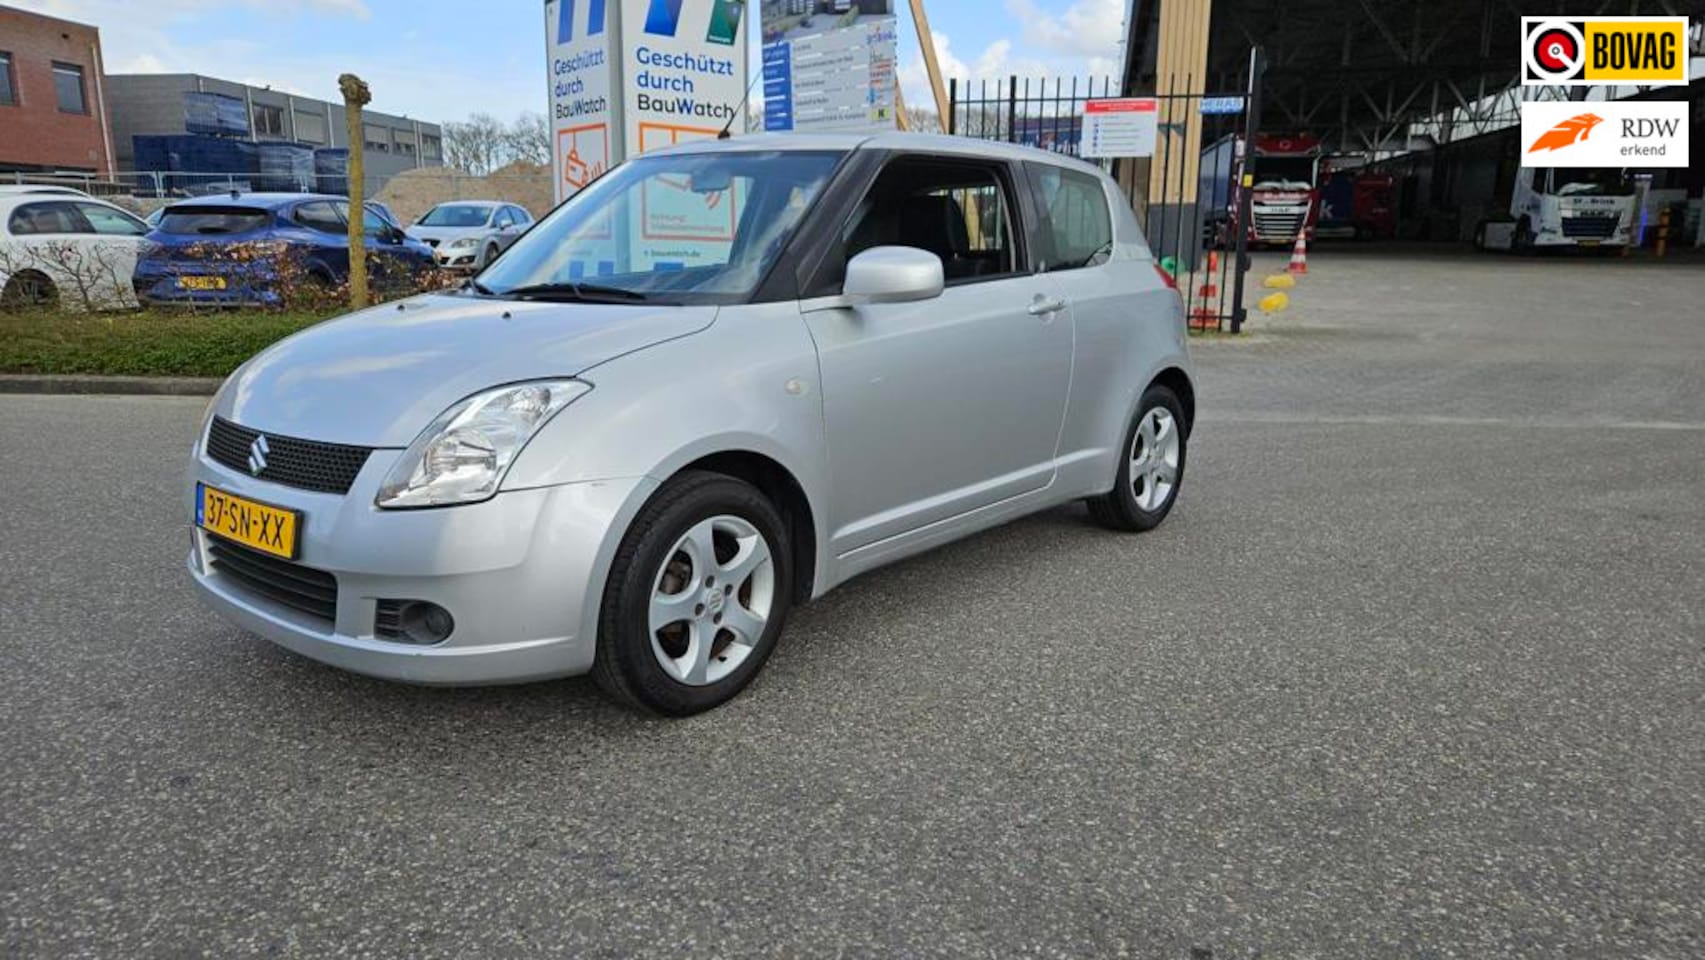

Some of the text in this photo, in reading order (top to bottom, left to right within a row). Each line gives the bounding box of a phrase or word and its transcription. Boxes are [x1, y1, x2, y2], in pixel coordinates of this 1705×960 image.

[554, 49, 605, 76] Geschützt
[636, 46, 734, 77] Geschützt
[554, 77, 584, 98] durch
[636, 70, 694, 94] durch
[555, 96, 607, 120] BauWatch
[637, 94, 736, 121] BauWatch
[206, 493, 284, 549] 37-SN-XX
